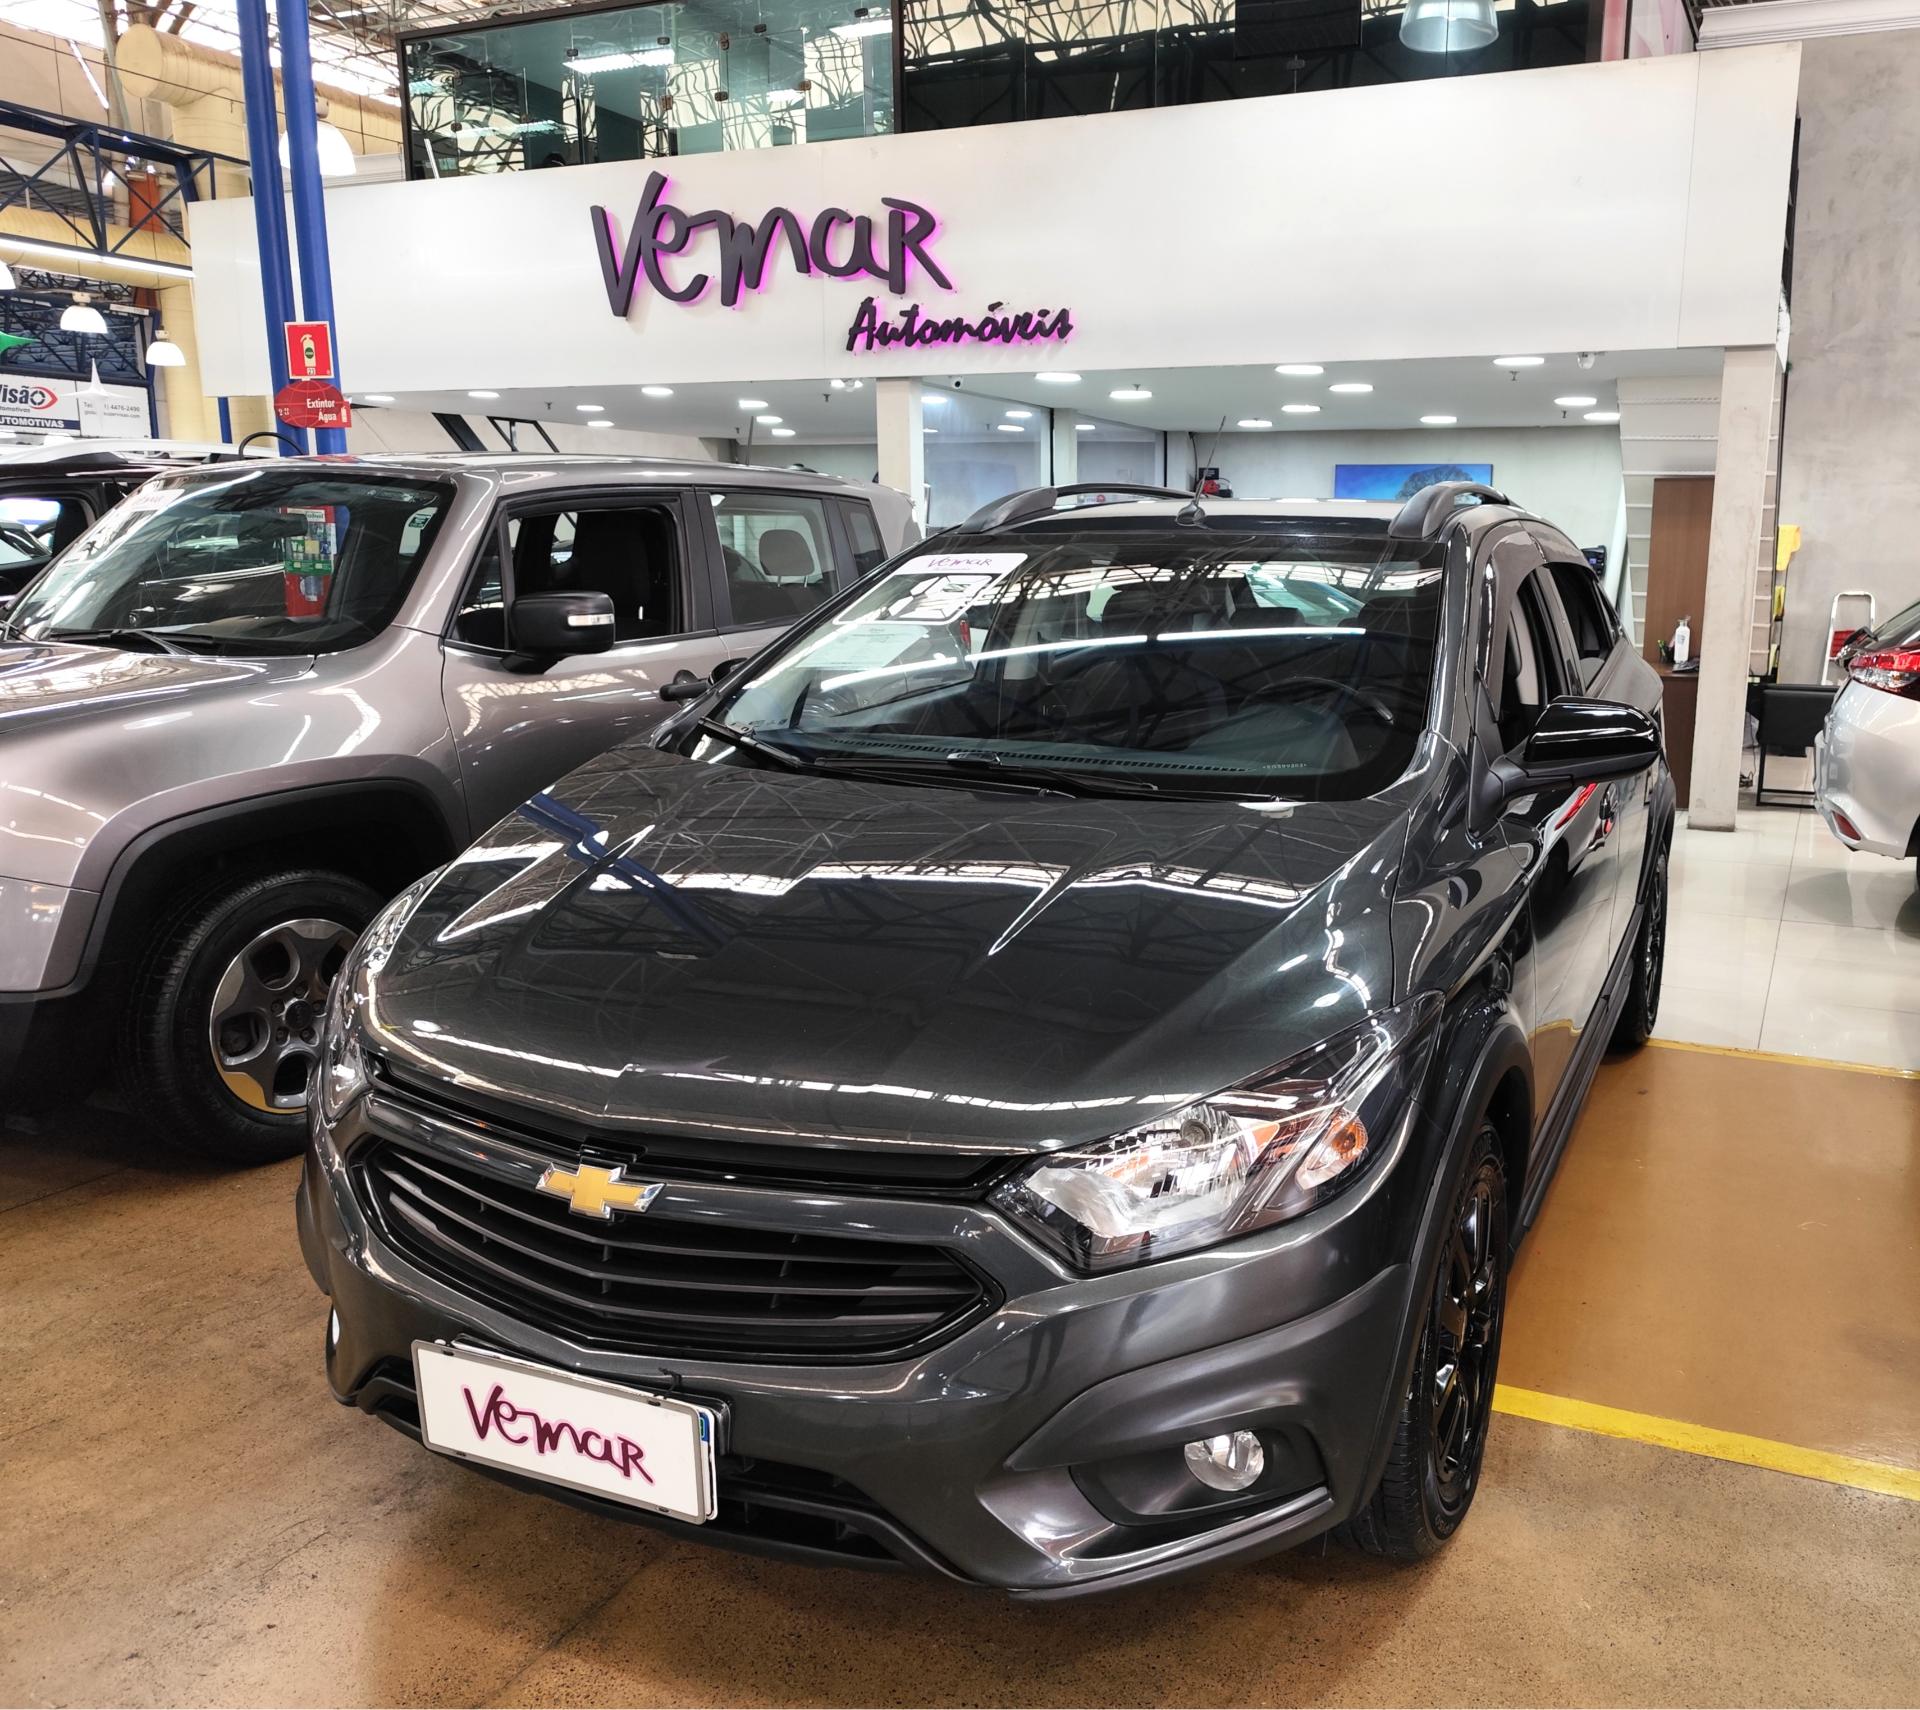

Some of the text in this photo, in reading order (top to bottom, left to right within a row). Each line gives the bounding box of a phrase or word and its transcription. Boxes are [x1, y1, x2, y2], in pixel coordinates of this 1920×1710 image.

[846, 296, 1074, 352] Automóveis
[0, 384, 46, 406] isão
[306, 398, 335, 409] Extintor
[318, 408, 337, 423] Água
